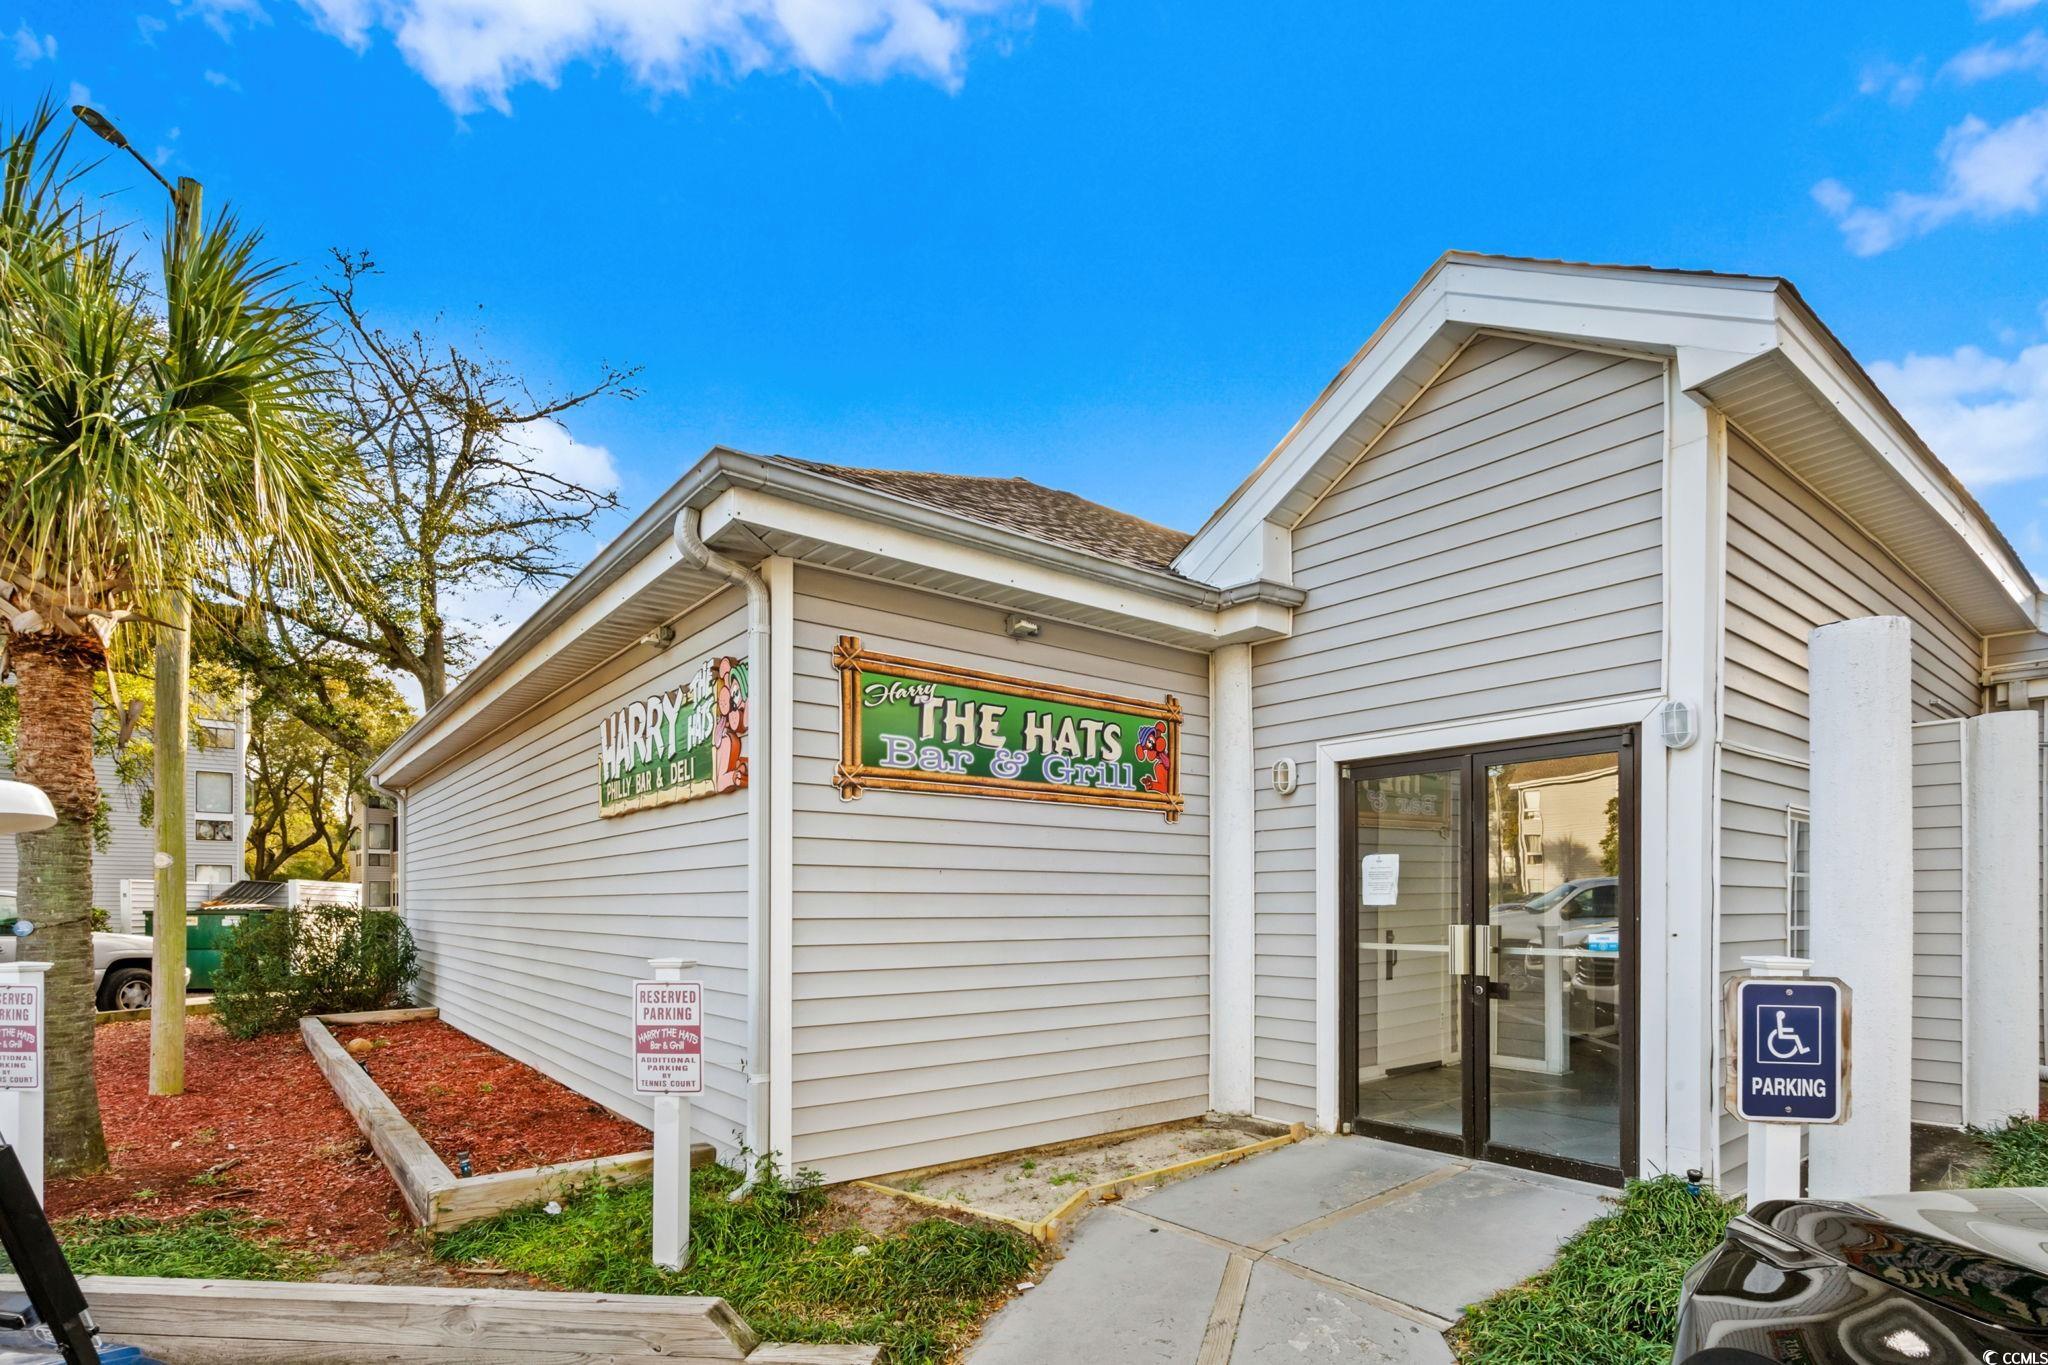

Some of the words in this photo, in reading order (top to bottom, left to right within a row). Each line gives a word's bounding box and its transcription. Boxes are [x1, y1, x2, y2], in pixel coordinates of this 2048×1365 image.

[689, 658, 714, 709] THE
[864, 682, 937, 707] Harry
[687, 696, 714, 752] HATS
[914, 694, 1007, 749] THE
[1023, 710, 1123, 763] HATS
[600, 686, 684, 783] HARRY
[879, 733, 975, 776] Bar
[990, 747, 1029, 780] &
[1042, 754, 1138, 792] Grill
[606, 776, 632, 802] PHILLY
[636, 770, 652, 794] BAR
[656, 766, 664, 788] &
[670, 757, 695, 784] DELI
[0, 993, 33, 1006] ERVED
[640, 990, 696, 1004] RESERVED
[643, 1007, 692, 1020] PARKING
[2, 1028, 16, 1038] THE
[17, 1030, 35, 1044] HATS
[638, 1029, 661, 1044] HARRY
[661, 1027, 678, 1038] THE
[678, 1030, 699, 1044] HATS
[650, 1041, 662, 1050] Bar
[662, 1041, 669, 1050] &
[670, 1041, 685, 1050] Grill
[641, 1056, 697, 1064] ADDITIONAL
[647, 1064, 689, 1072] PARKING
[641, 1079, 667, 1088] TENNIS
[670, 1080, 697, 1088] COURT
[1752, 1077, 1826, 1097] PARKING
